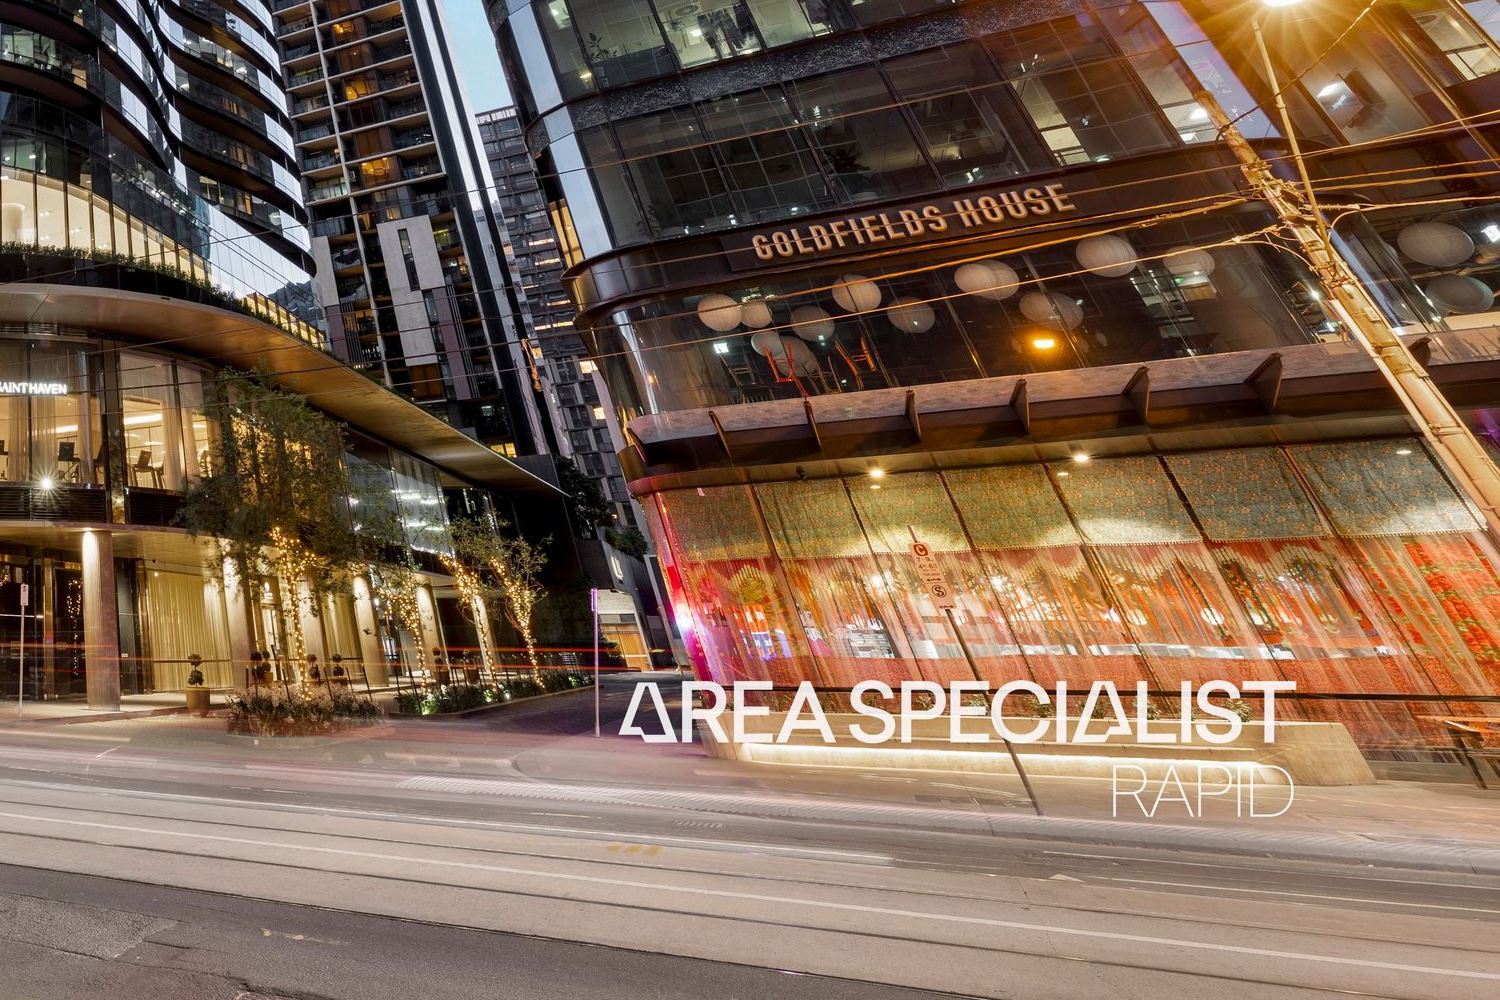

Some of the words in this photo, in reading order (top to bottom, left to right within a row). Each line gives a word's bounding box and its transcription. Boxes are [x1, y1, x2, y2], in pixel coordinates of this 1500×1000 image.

[752, 205, 947, 260] GOLDFIELDS
[953, 183, 1076, 228] HOUSE
[29, 382, 68, 394] HAVEN
